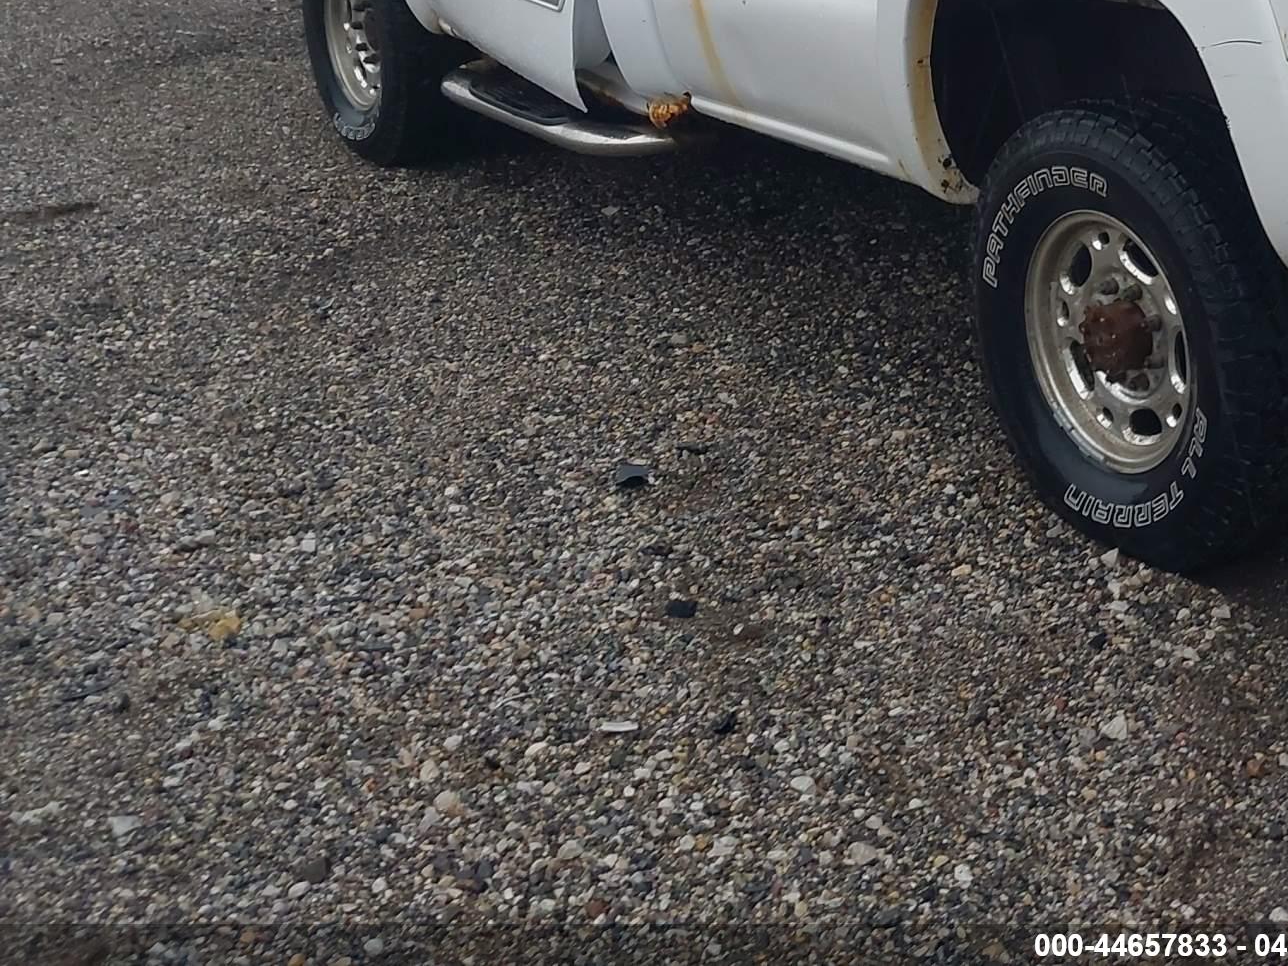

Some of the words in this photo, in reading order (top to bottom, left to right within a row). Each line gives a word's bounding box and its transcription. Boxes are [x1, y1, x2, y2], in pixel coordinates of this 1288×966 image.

[983, 166, 1108, 288] PATHFINDER
[1181, 407, 1207, 479] ALL
[1063, 481, 1184, 528] TERRAIN
